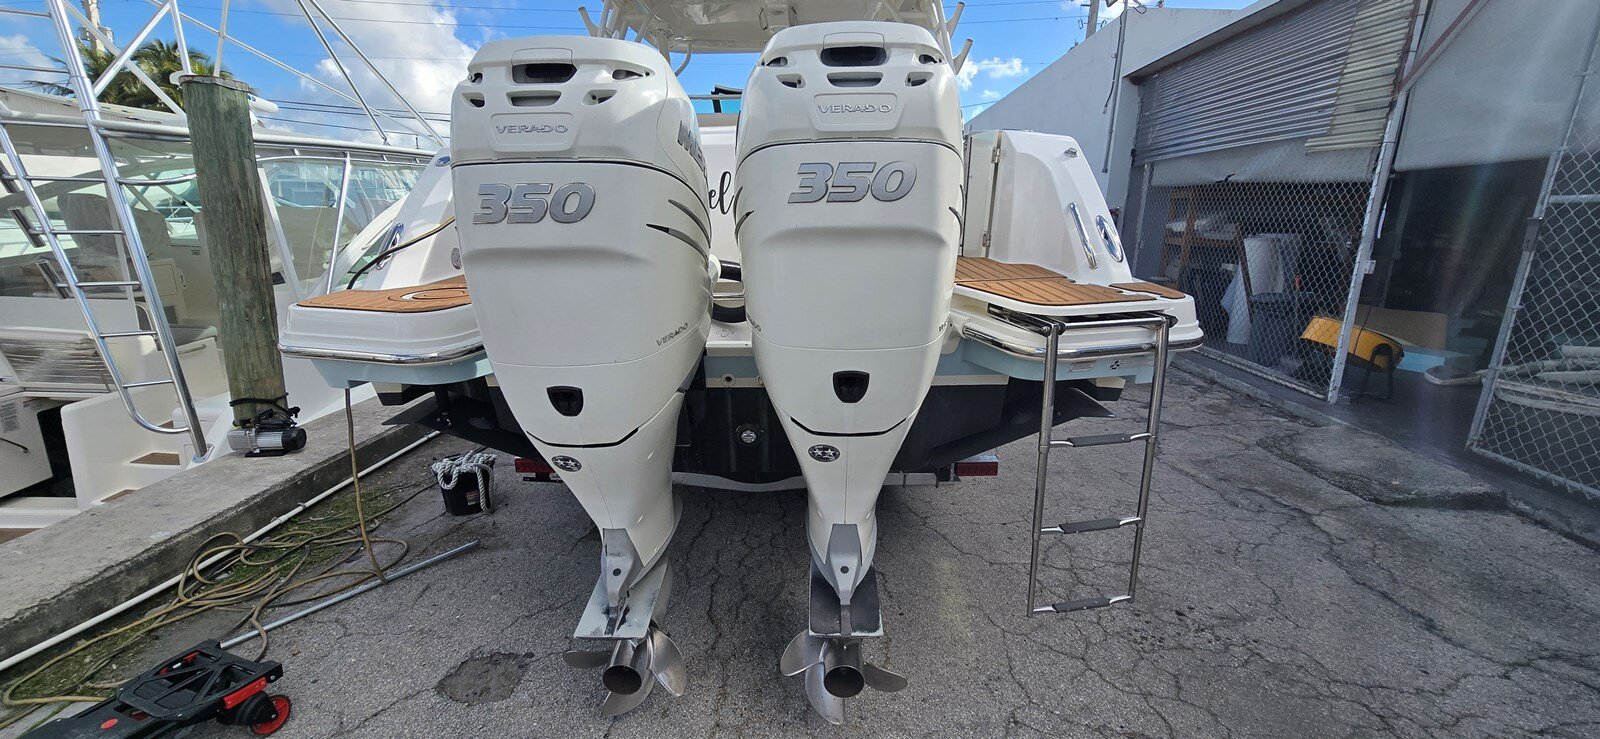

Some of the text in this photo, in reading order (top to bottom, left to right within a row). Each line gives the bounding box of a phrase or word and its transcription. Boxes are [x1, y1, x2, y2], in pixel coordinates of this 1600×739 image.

[818, 104, 892, 114] VERADO
[495, 124, 569, 134] VERADO
[787, 161, 918, 204] 350
[472, 182, 596, 225] 350
